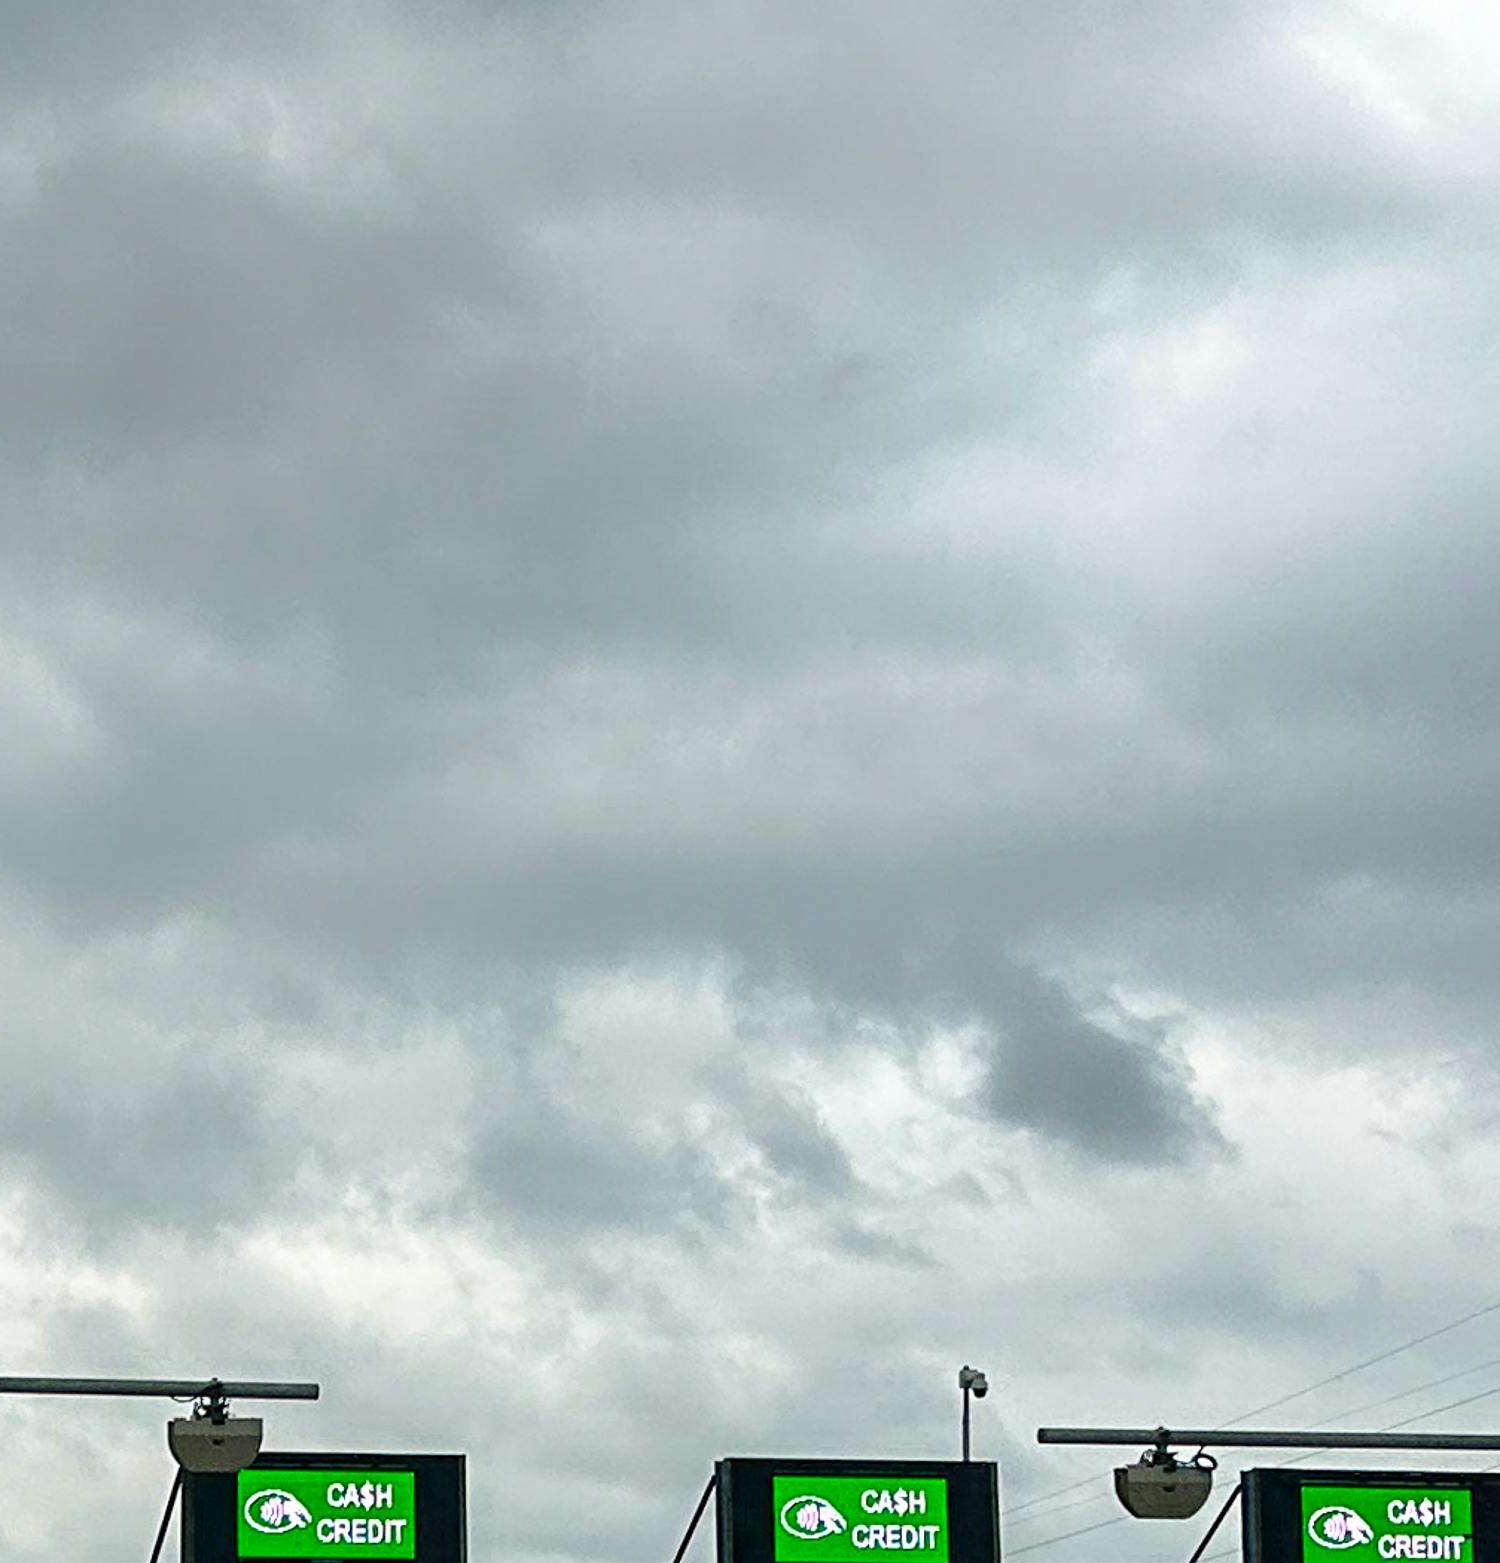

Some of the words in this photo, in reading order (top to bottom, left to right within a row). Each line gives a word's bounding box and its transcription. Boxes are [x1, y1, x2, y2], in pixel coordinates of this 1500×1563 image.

[326, 1480, 393, 1511] CA$H
[860, 1487, 927, 1516] CA$H
[1387, 1497, 1451, 1528] CA$H
[316, 1519, 407, 1544] CREDIT
[851, 1524, 940, 1550] CREDIT
[1377, 1534, 1465, 1560] CREDIT
